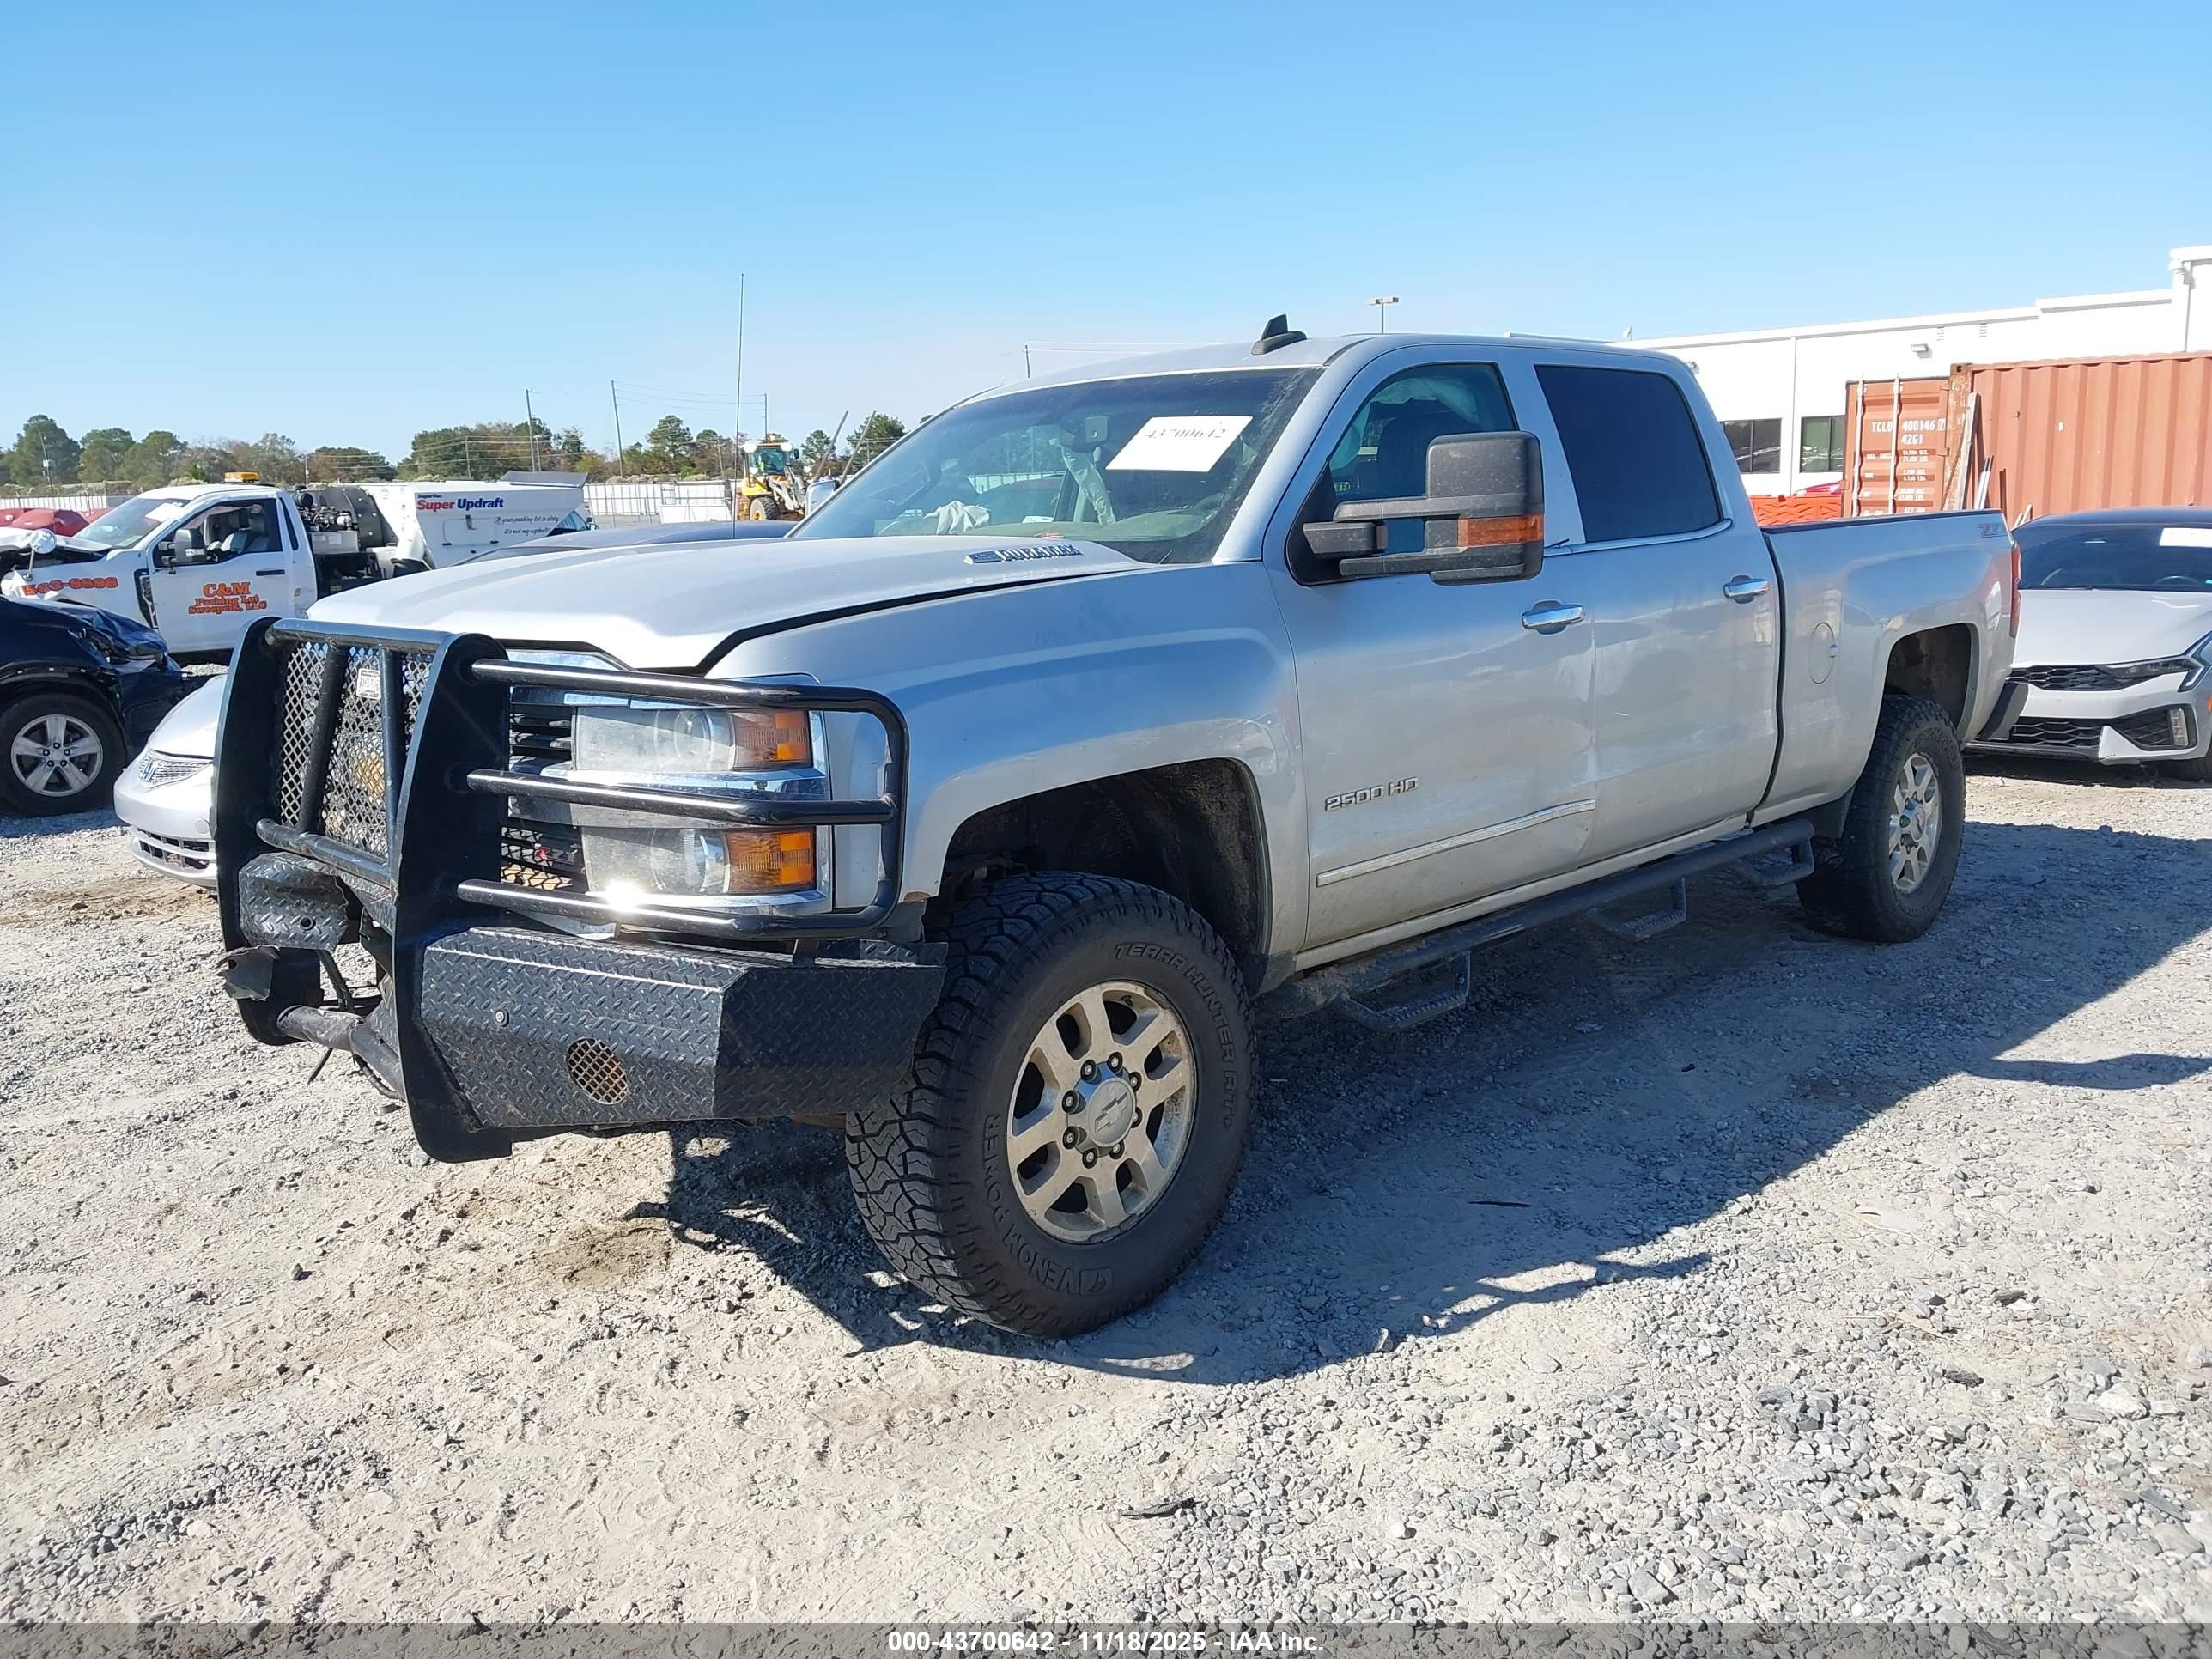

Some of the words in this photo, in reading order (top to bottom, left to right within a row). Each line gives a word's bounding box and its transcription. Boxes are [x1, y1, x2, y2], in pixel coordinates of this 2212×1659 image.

[1901, 419, 1936, 430] 400146
[416, 499, 455, 512] Super
[457, 497, 505, 511] Updraft
[994, 544, 1084, 562] DURAMAX
[203, 582, 251, 598] C&M
[195, 596, 240, 607] Parking
[241, 594, 259, 605] Lot
[1325, 785, 1384, 811] 2500
[1388, 776, 1419, 796] HD
[1115, 942, 1188, 971] TERRA
[1183, 964, 1237, 1064] HUNTER
[982, 1113, 1011, 1229] POWER
[1002, 1223, 1072, 1294] VENOM
